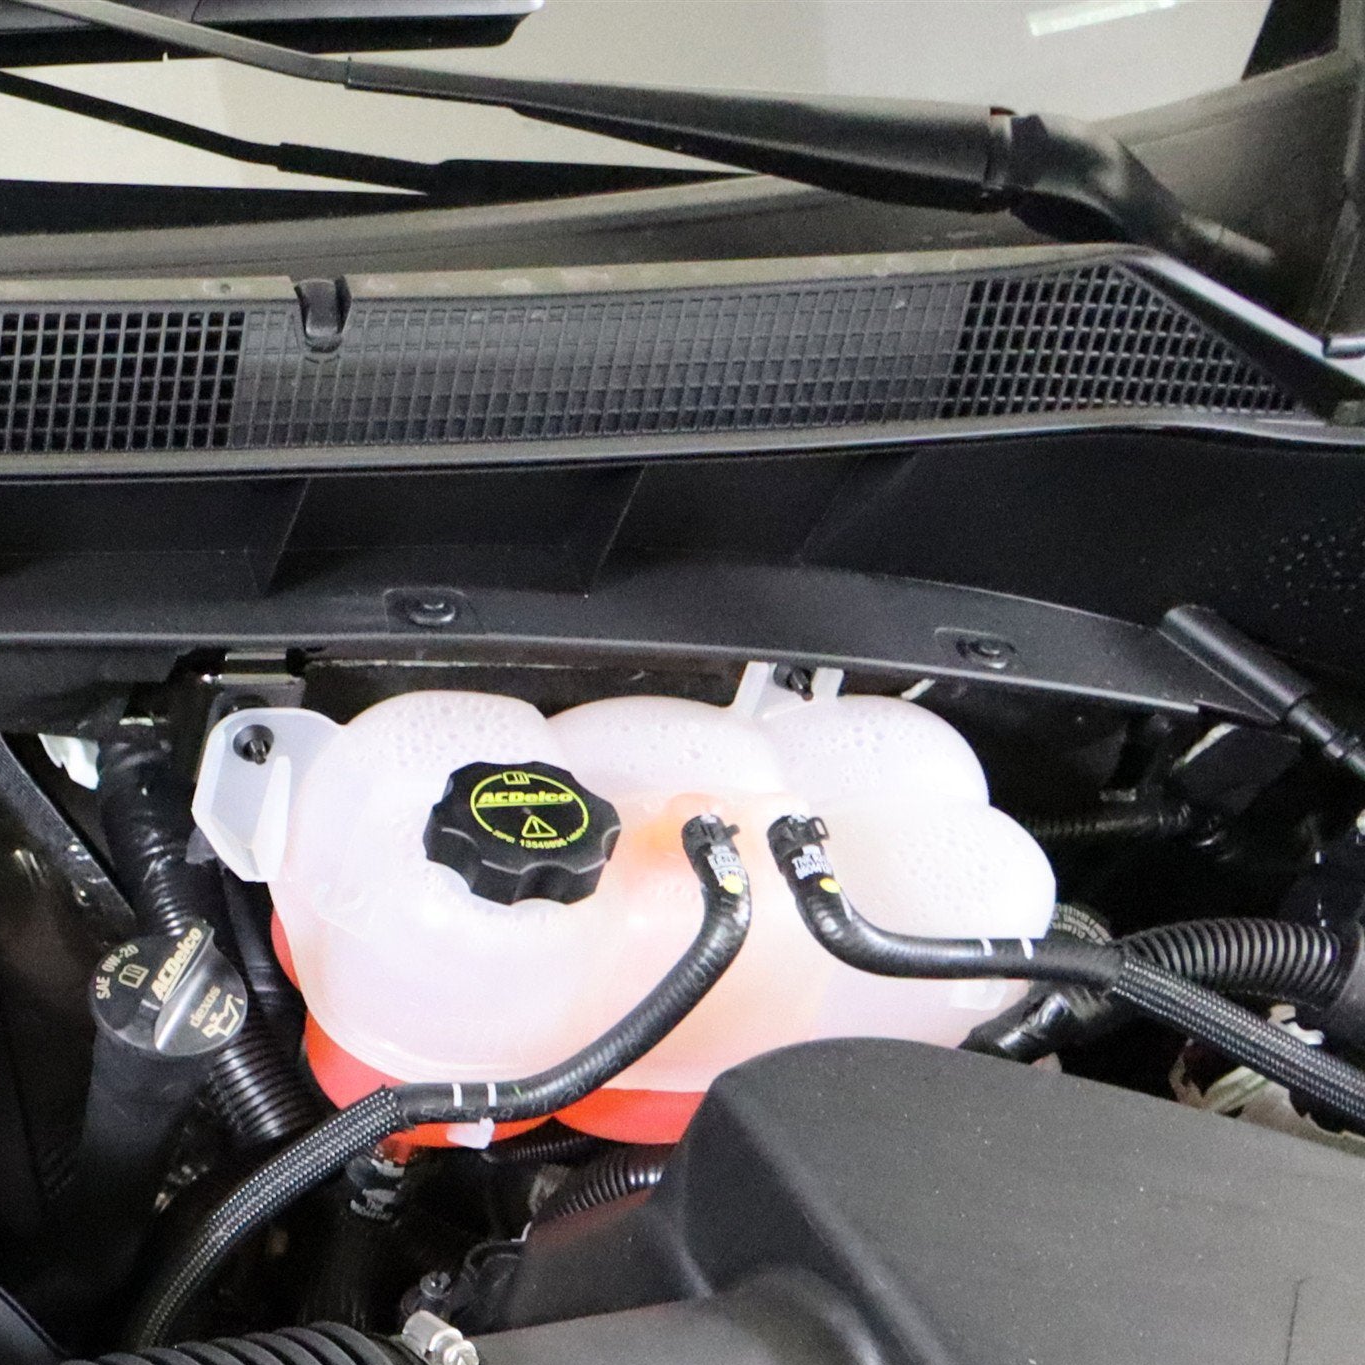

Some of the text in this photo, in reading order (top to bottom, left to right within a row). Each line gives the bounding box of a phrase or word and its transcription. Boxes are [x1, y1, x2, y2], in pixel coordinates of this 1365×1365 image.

[476, 790, 575, 805] ACDelco
[95, 944, 139, 1000] SAE 0W-20
[150, 927, 203, 1001] ACDelco
[189, 985, 221, 1029] dexos
